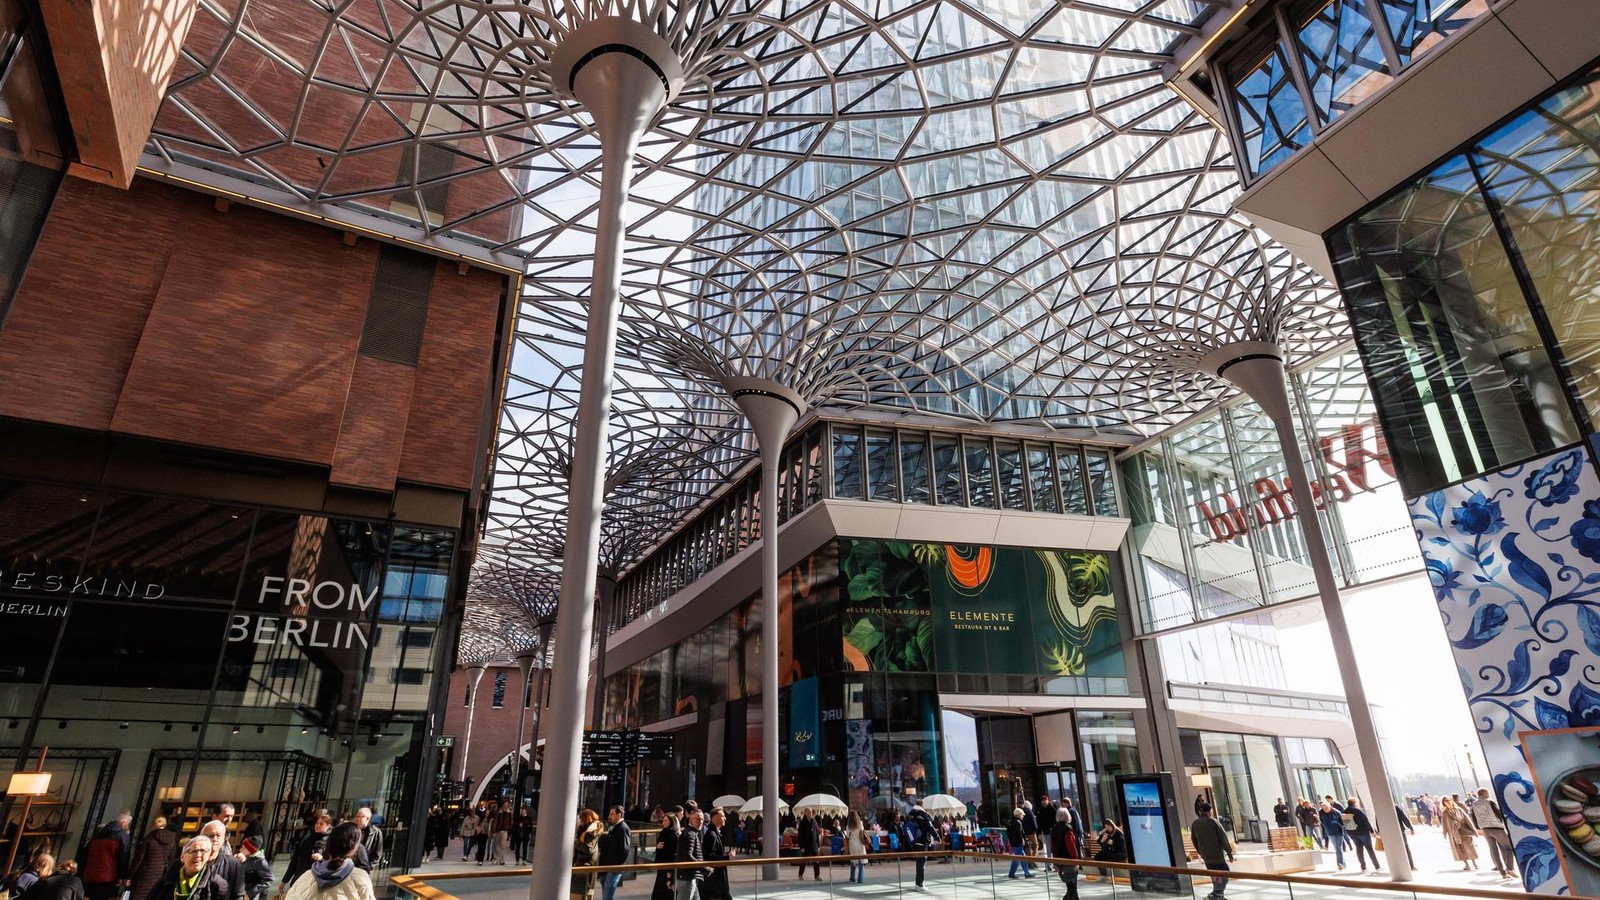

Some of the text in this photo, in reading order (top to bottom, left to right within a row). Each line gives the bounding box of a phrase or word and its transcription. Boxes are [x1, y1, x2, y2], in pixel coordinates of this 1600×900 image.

[0, 571, 165, 600] ESKIND
[257, 575, 379, 612] FROM
[223, 614, 369, 650] BERLIN
[949, 611, 1015, 622] ELEMENTE
